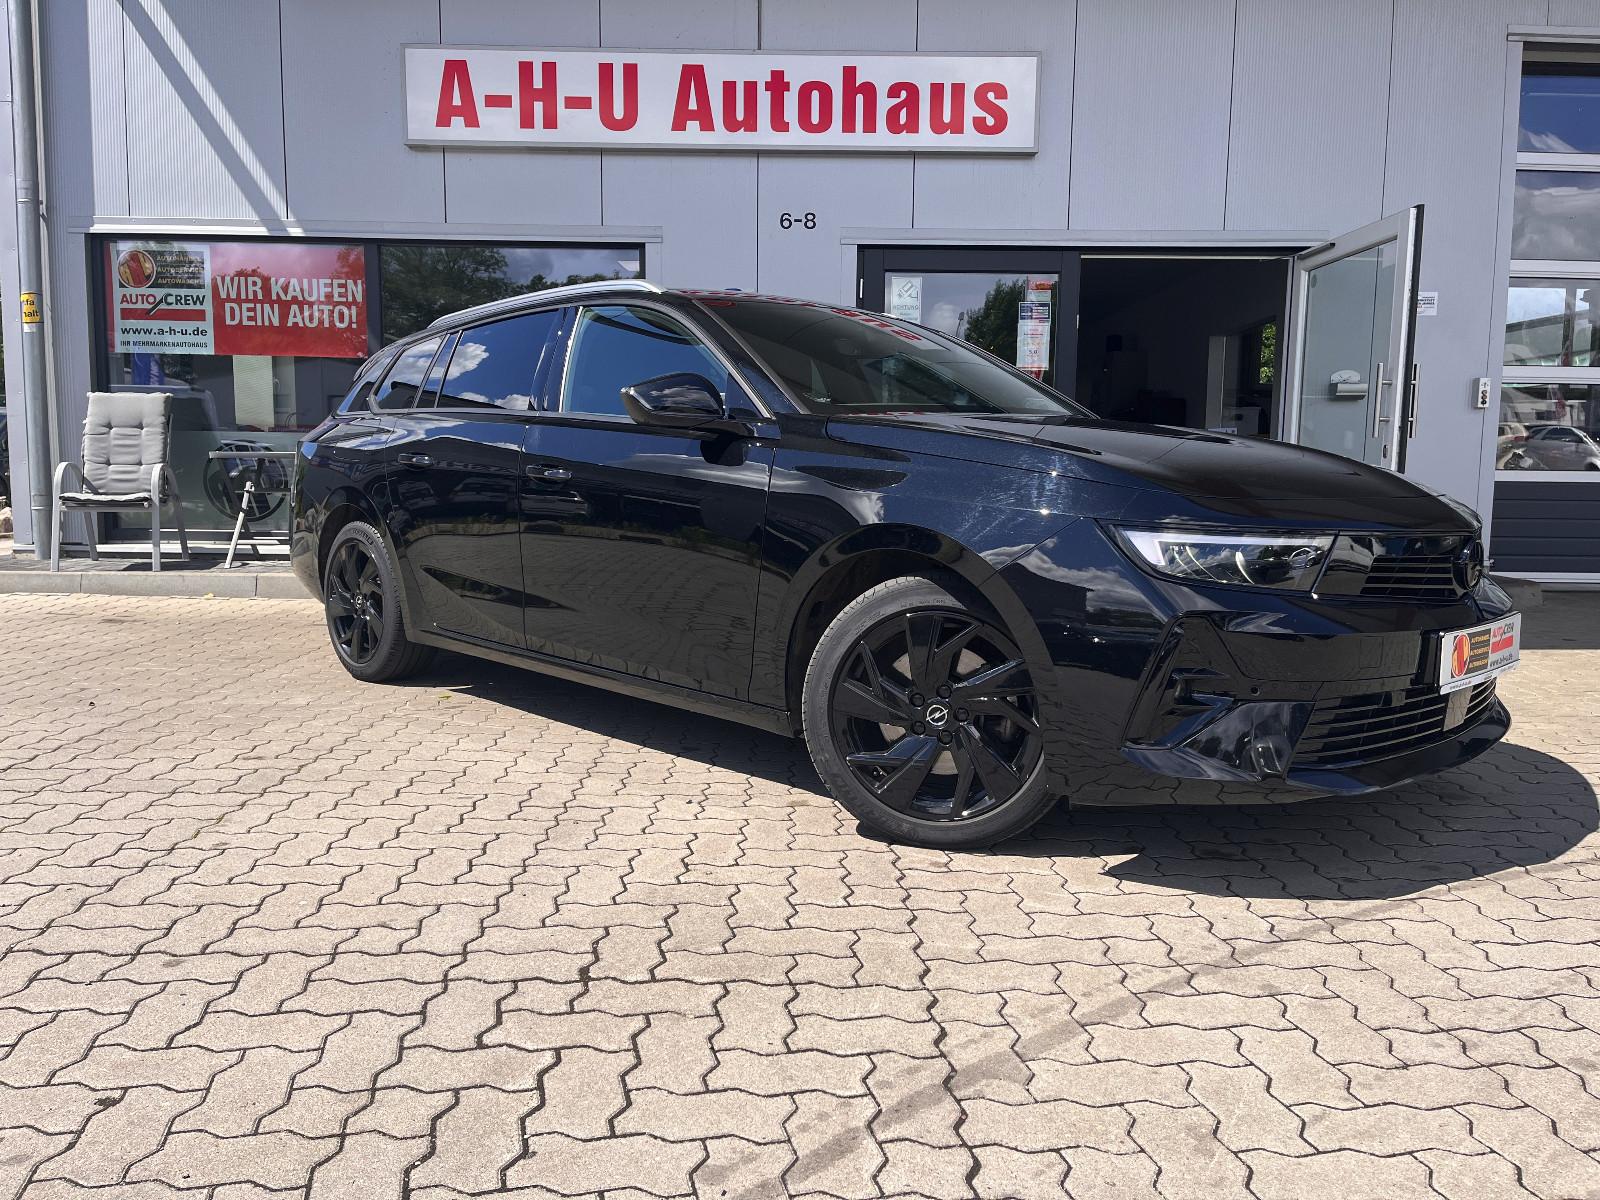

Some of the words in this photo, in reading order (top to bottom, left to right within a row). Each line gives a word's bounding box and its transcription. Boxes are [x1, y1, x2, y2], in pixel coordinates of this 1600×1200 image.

[435, 58, 640, 132] A-H-U
[670, 63, 1010, 136] Autohaus
[779, 212, 818, 230] 6-8
[216, 275, 263, 300] WIR
[271, 277, 363, 303] KAUFEN
[120, 293, 157, 305] AUTO
[164, 293, 206, 306] CREW
[224, 302, 280, 327] DEIN
[287, 304, 357, 328] AUTO!
[120, 326, 208, 337] www.a-h-u.de
[132, 340, 208, 348] MEHRMARKENAUTOHAUS
